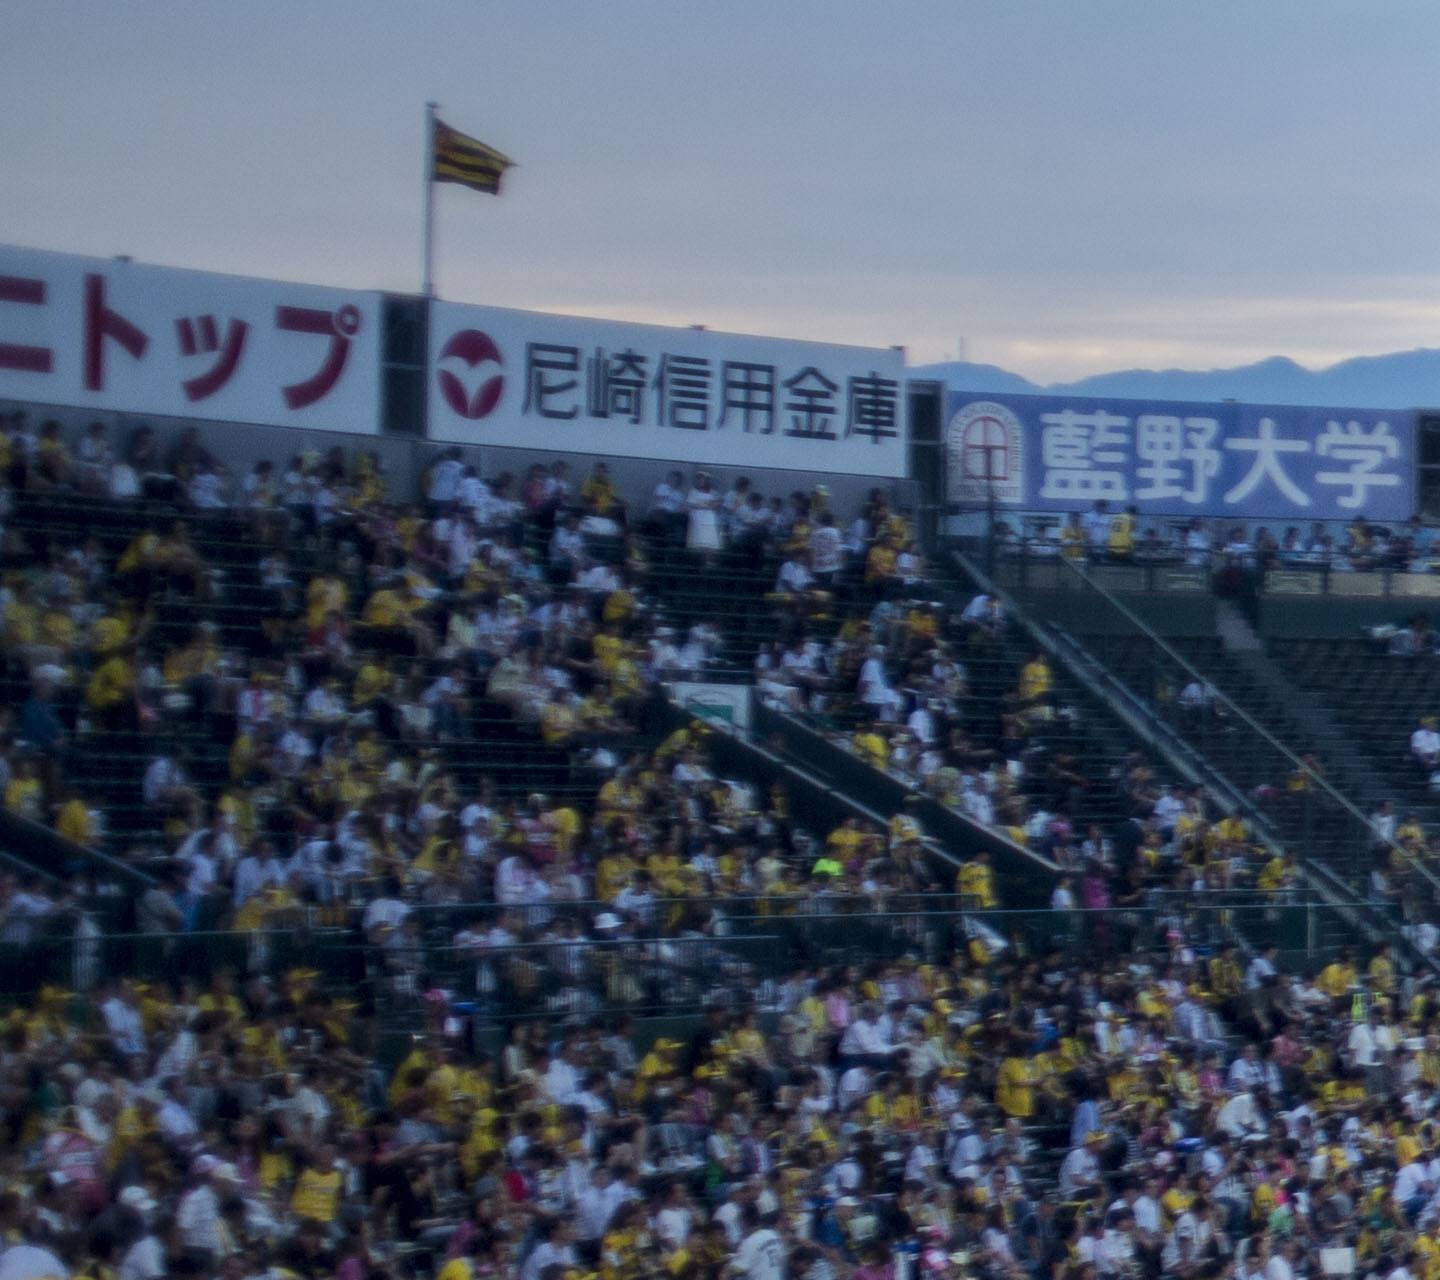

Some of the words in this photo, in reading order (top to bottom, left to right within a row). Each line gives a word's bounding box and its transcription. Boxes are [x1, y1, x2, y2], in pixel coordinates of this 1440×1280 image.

[520, 341, 901, 446] 尼崎信用金庫
[1038, 408, 1402, 511] 藍野大学
